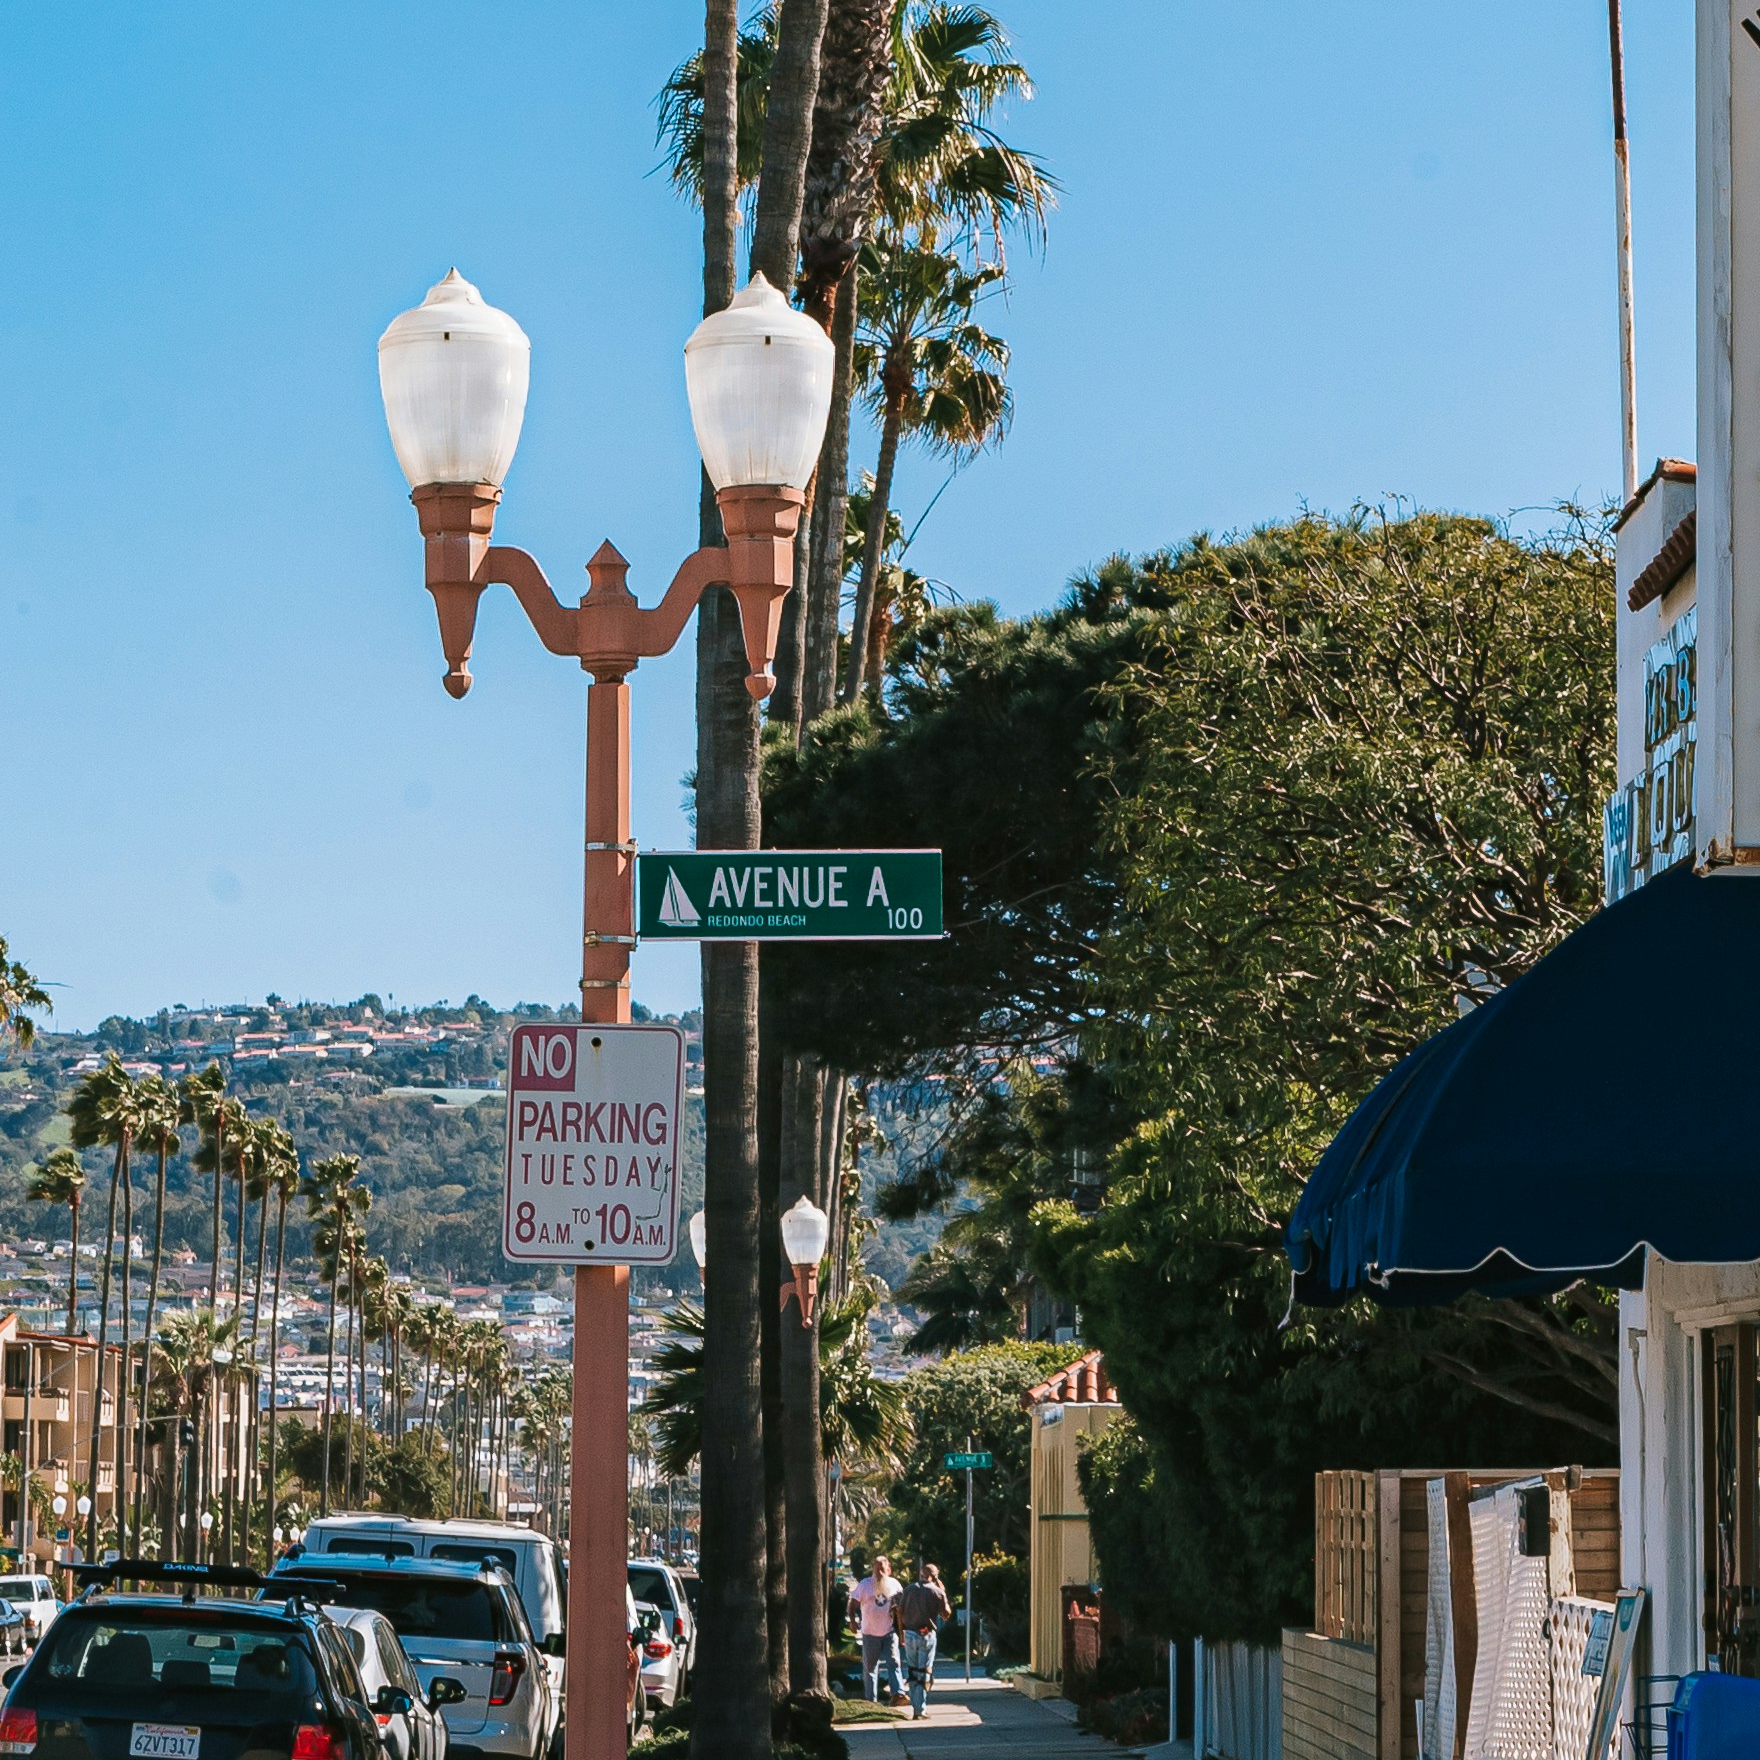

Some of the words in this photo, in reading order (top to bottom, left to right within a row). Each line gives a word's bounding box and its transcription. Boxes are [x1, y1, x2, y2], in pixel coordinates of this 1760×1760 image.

[707, 866, 848, 908] AVENUE
[866, 865, 890, 907] A
[707, 915, 764, 927] REDONDO
[768, 915, 806, 927] BEACH
[888, 907, 923, 930] 100
[520, 1034, 573, 1079] NO
[518, 1100, 668, 1145] PARKING
[521, 1153, 662, 1187] TUESDAY
[515, 1201, 536, 1243] 8
[538, 1222, 574, 1245] A.M.
[572, 1207, 591, 1225] TO
[595, 1203, 632, 1245] 10
[632, 1224, 667, 1246] A.M.
[134, 1734, 196, 1757] 6ZVT317
